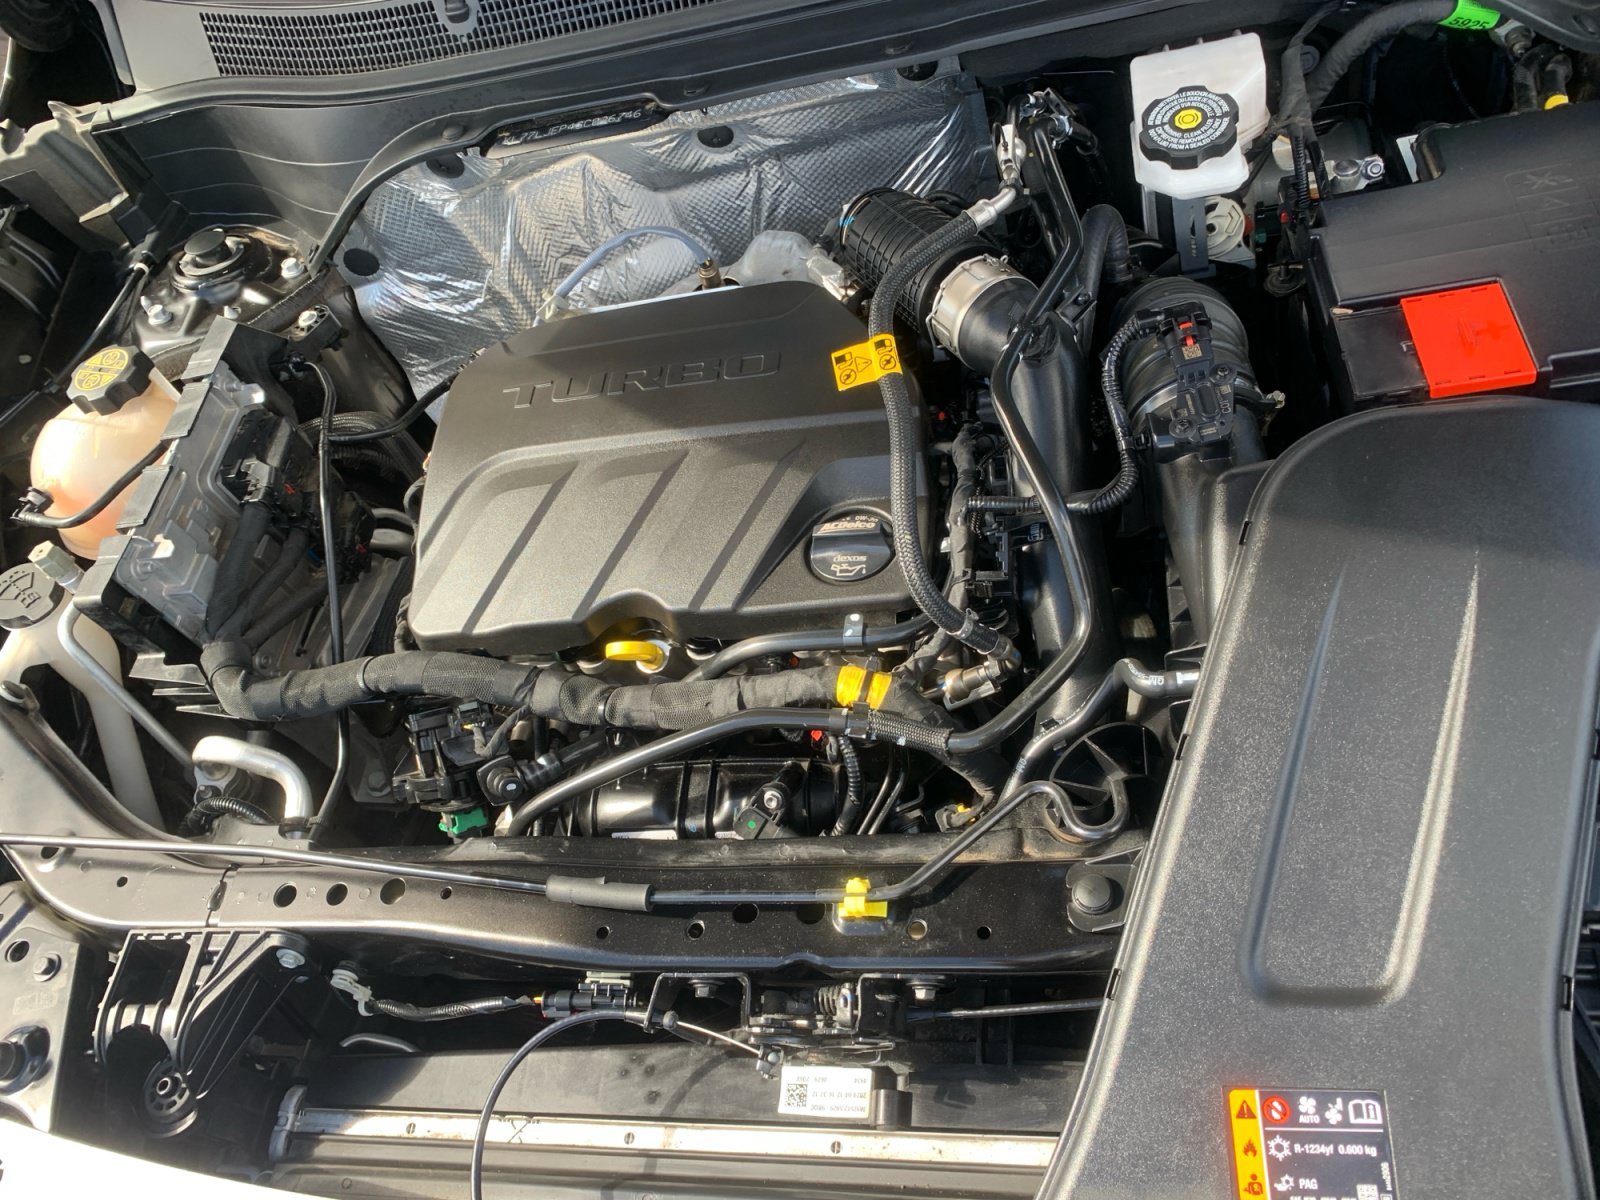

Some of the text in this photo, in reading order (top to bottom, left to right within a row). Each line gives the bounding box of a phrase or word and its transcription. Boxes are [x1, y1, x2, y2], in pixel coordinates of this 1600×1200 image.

[502, 352, 782, 408] TURBO
[820, 521, 876, 532] ACDelco
[1299, 1115, 1320, 1123] AUTO
[1294, 1144, 1334, 1156] R-1234yf
[1365, 1145, 1377, 1157] kg
[1299, 1178, 1318, 1190] PAG
